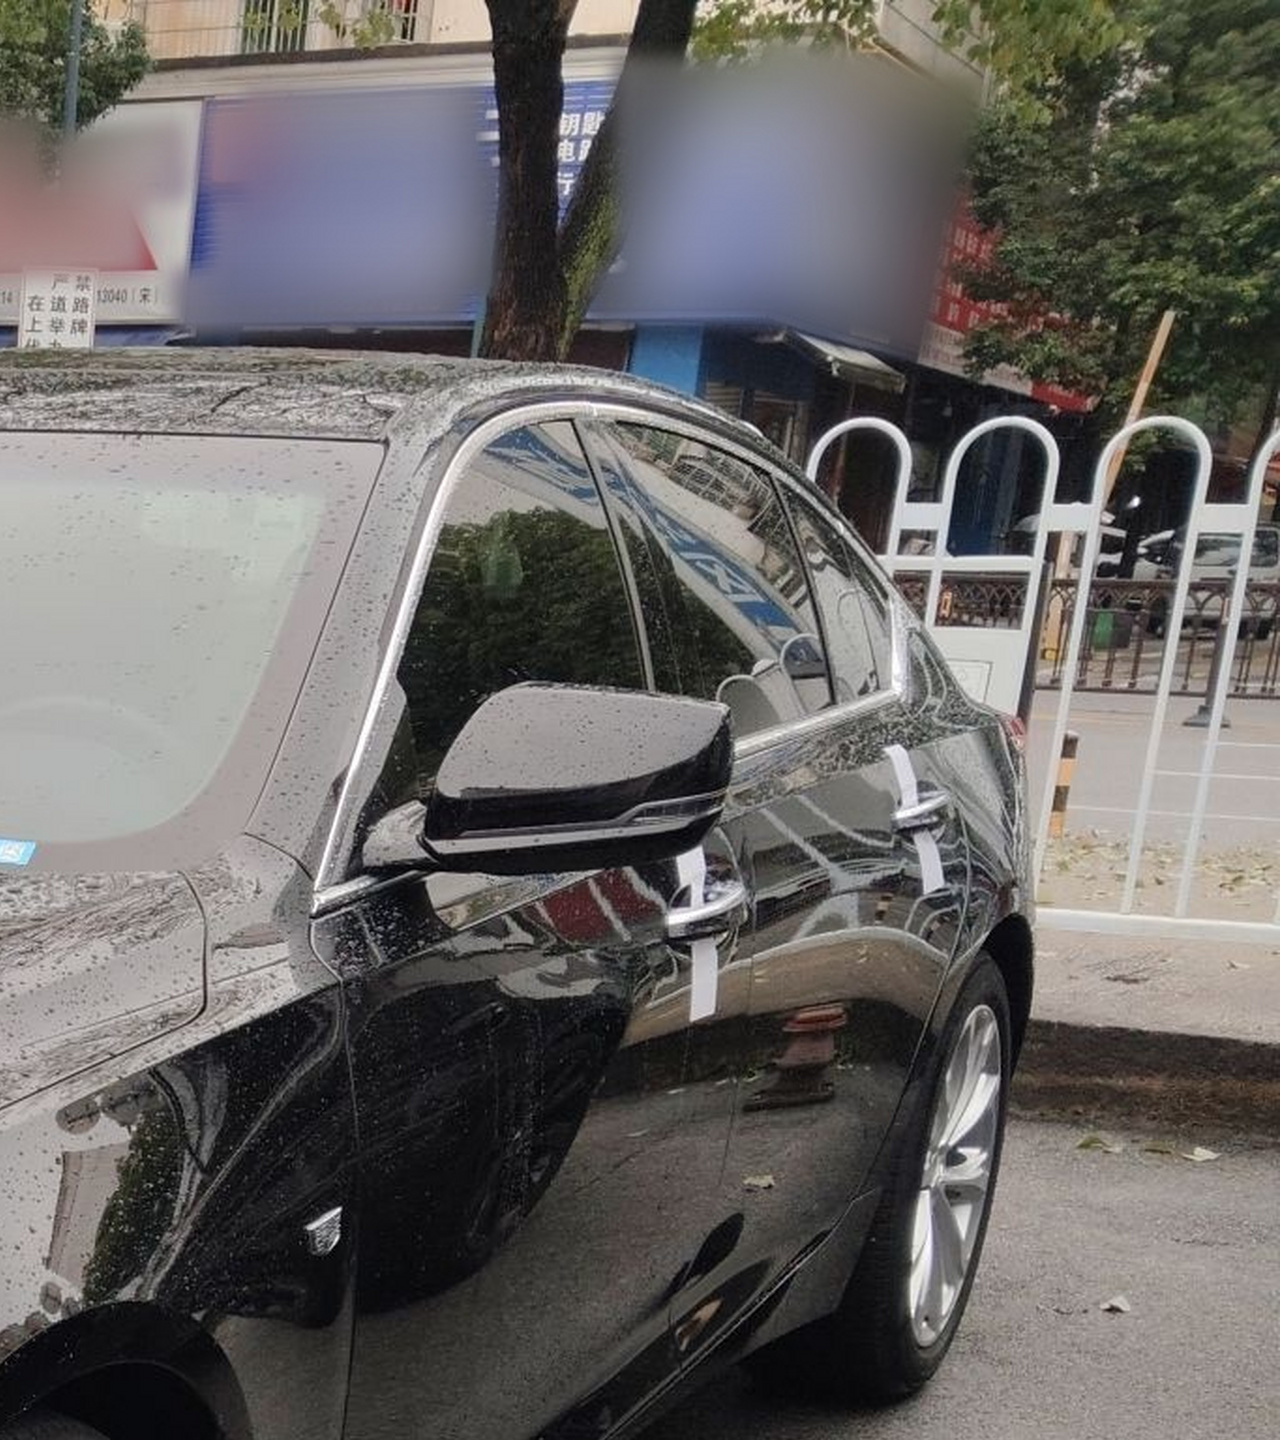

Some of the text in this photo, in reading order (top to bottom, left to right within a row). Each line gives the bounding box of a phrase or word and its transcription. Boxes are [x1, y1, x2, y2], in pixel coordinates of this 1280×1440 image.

[51, 273, 92, 292] 严禁
[26, 295, 90, 314] 在道路
